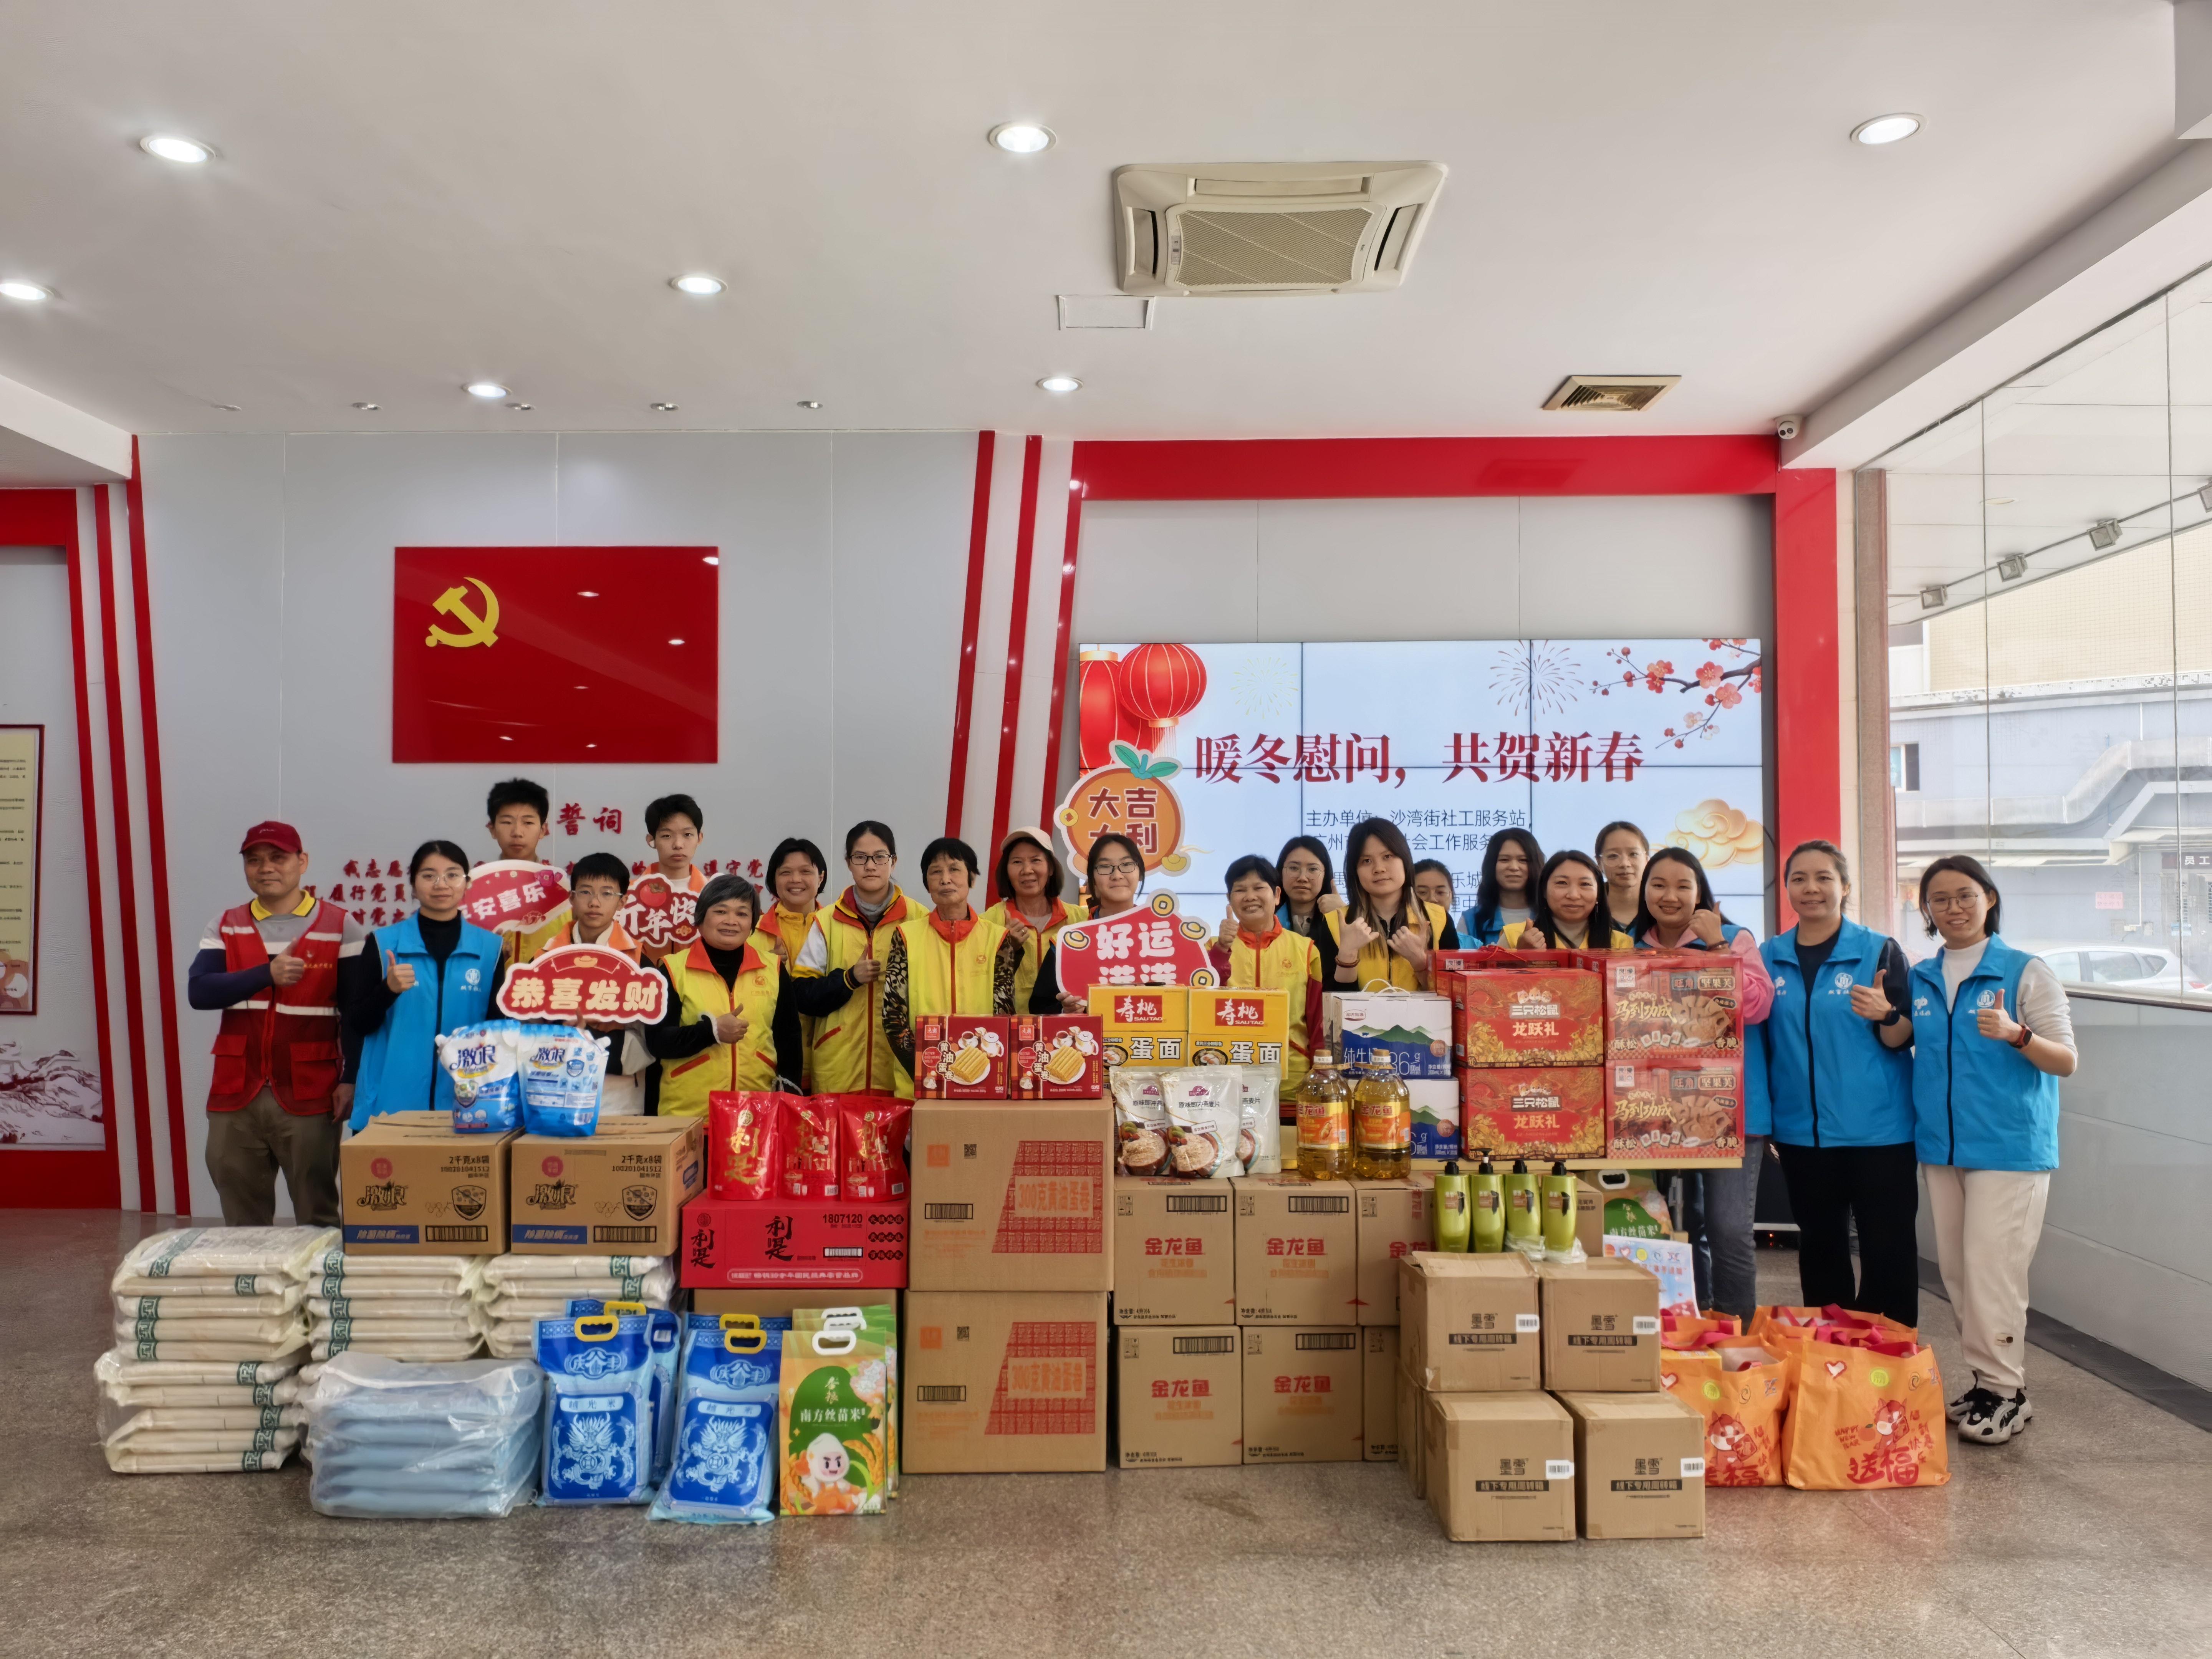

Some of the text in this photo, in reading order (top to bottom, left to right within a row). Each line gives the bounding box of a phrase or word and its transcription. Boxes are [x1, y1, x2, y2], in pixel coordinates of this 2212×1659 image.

[1088, 787, 1157, 819] 大吉
[1096, 921, 1175, 960] 好运
[510, 977, 659, 1012] 恭喜发财
[1116, 995, 1157, 1023] 寿桃
[1216, 998, 1258, 1025] 寿桃
[1511, 1004, 1559, 1017] 三只松鼠
[1610, 997, 1677, 1024] 马到功成
[1512, 1022, 1559, 1037] 龙跃礼
[1129, 1036, 1182, 1060] 蛋面
[1229, 1041, 1282, 1064] 蛋面
[1360, 1104, 1393, 1116] 金龙鱼
[1512, 1096, 1560, 1109] 三只松鼠
[1610, 1096, 1677, 1123] 马到功成
[1513, 1114, 1561, 1129] 龙跃礼
[823, 1214, 863, 1224] 1807120
[690, 1229, 716, 1268] 利是
[765, 1215, 794, 1262] 利是
[1145, 1238, 1204, 1256] 金龙鱼
[1266, 1238, 1326, 1256] 金龙鱼
[1151, 1379, 1210, 1398] 金龙鱼
[1274, 1376, 1331, 1393] 金龙鱼
[1846, 1447, 1919, 1485] 送福
